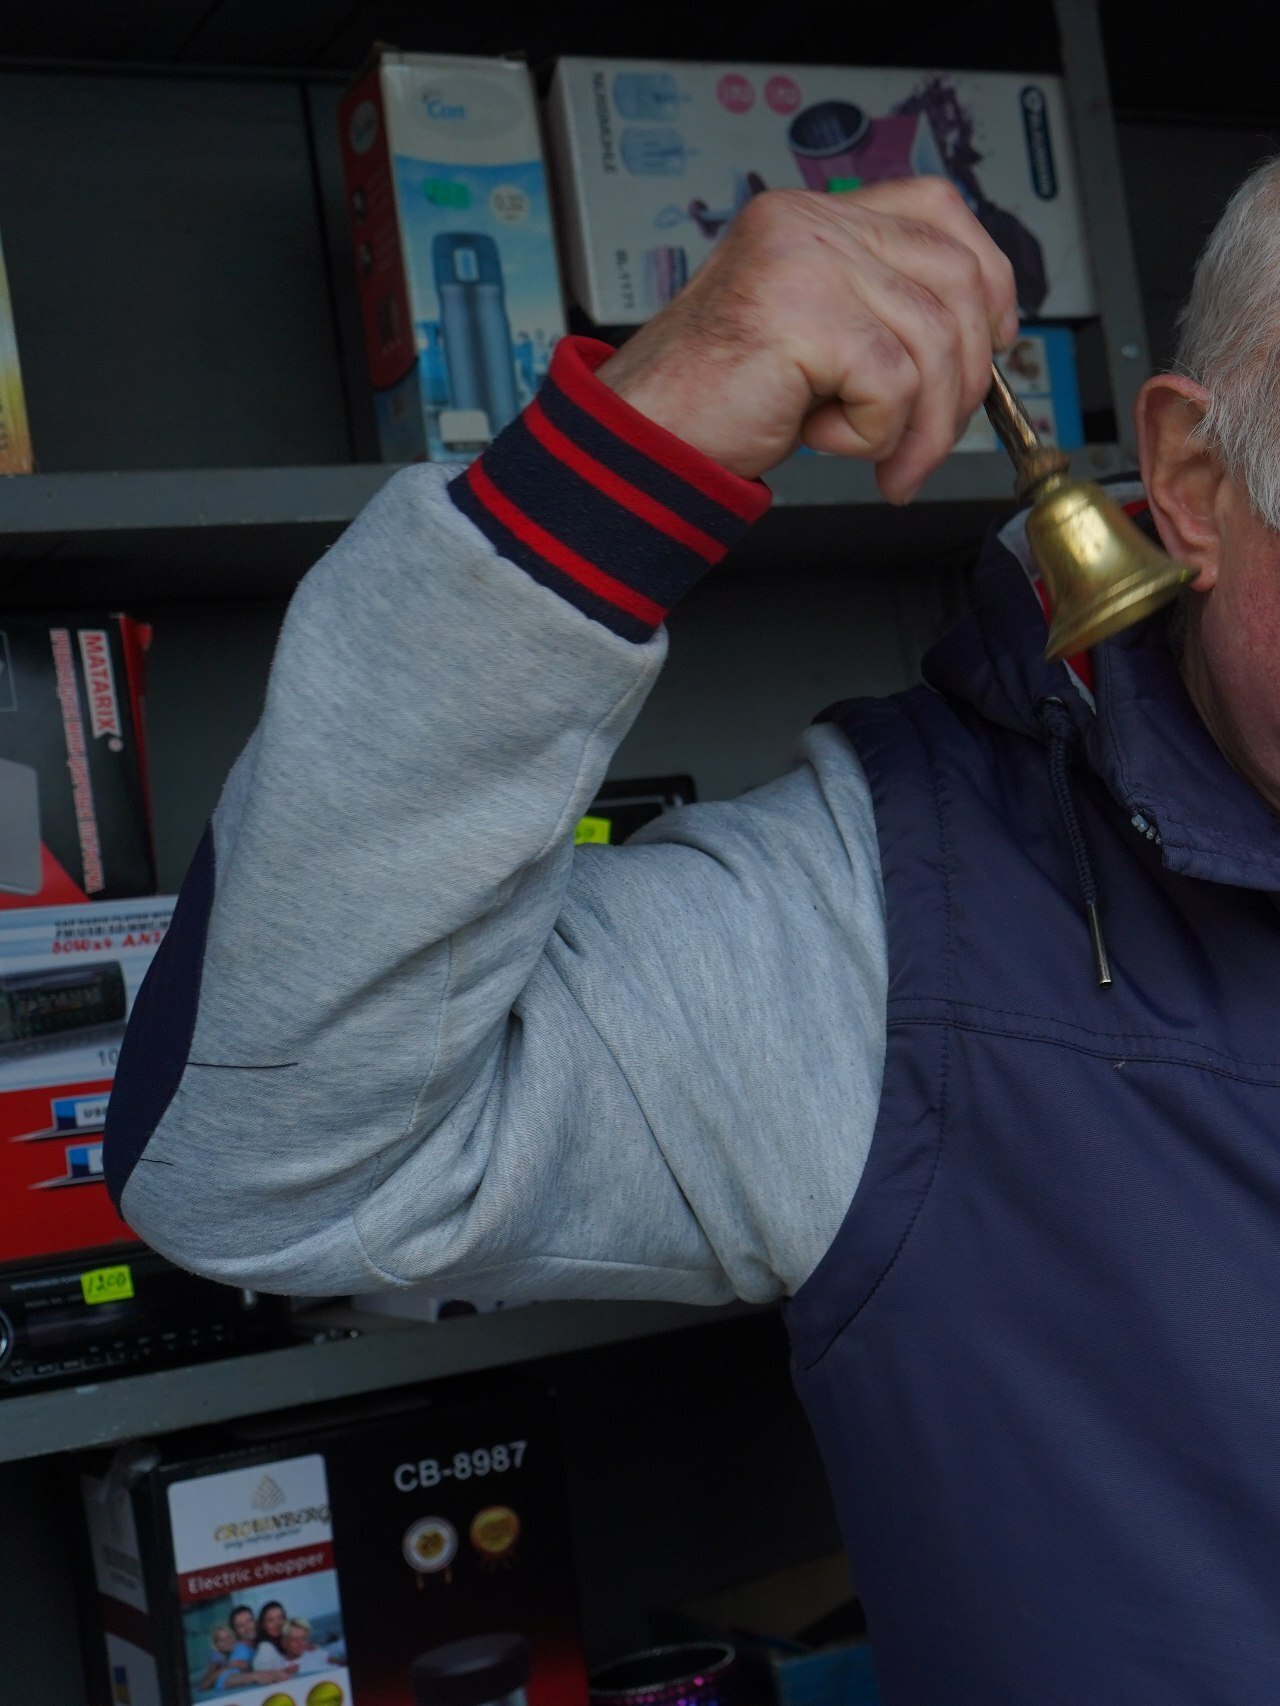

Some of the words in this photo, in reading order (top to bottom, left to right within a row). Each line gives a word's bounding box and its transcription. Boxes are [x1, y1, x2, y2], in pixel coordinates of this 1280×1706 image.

[83, 633, 115, 732] MATARIX
[393, 1440, 528, 1493] CB-8987
[187, 1567, 251, 1596] Electric
[253, 1551, 326, 1580] chopper
